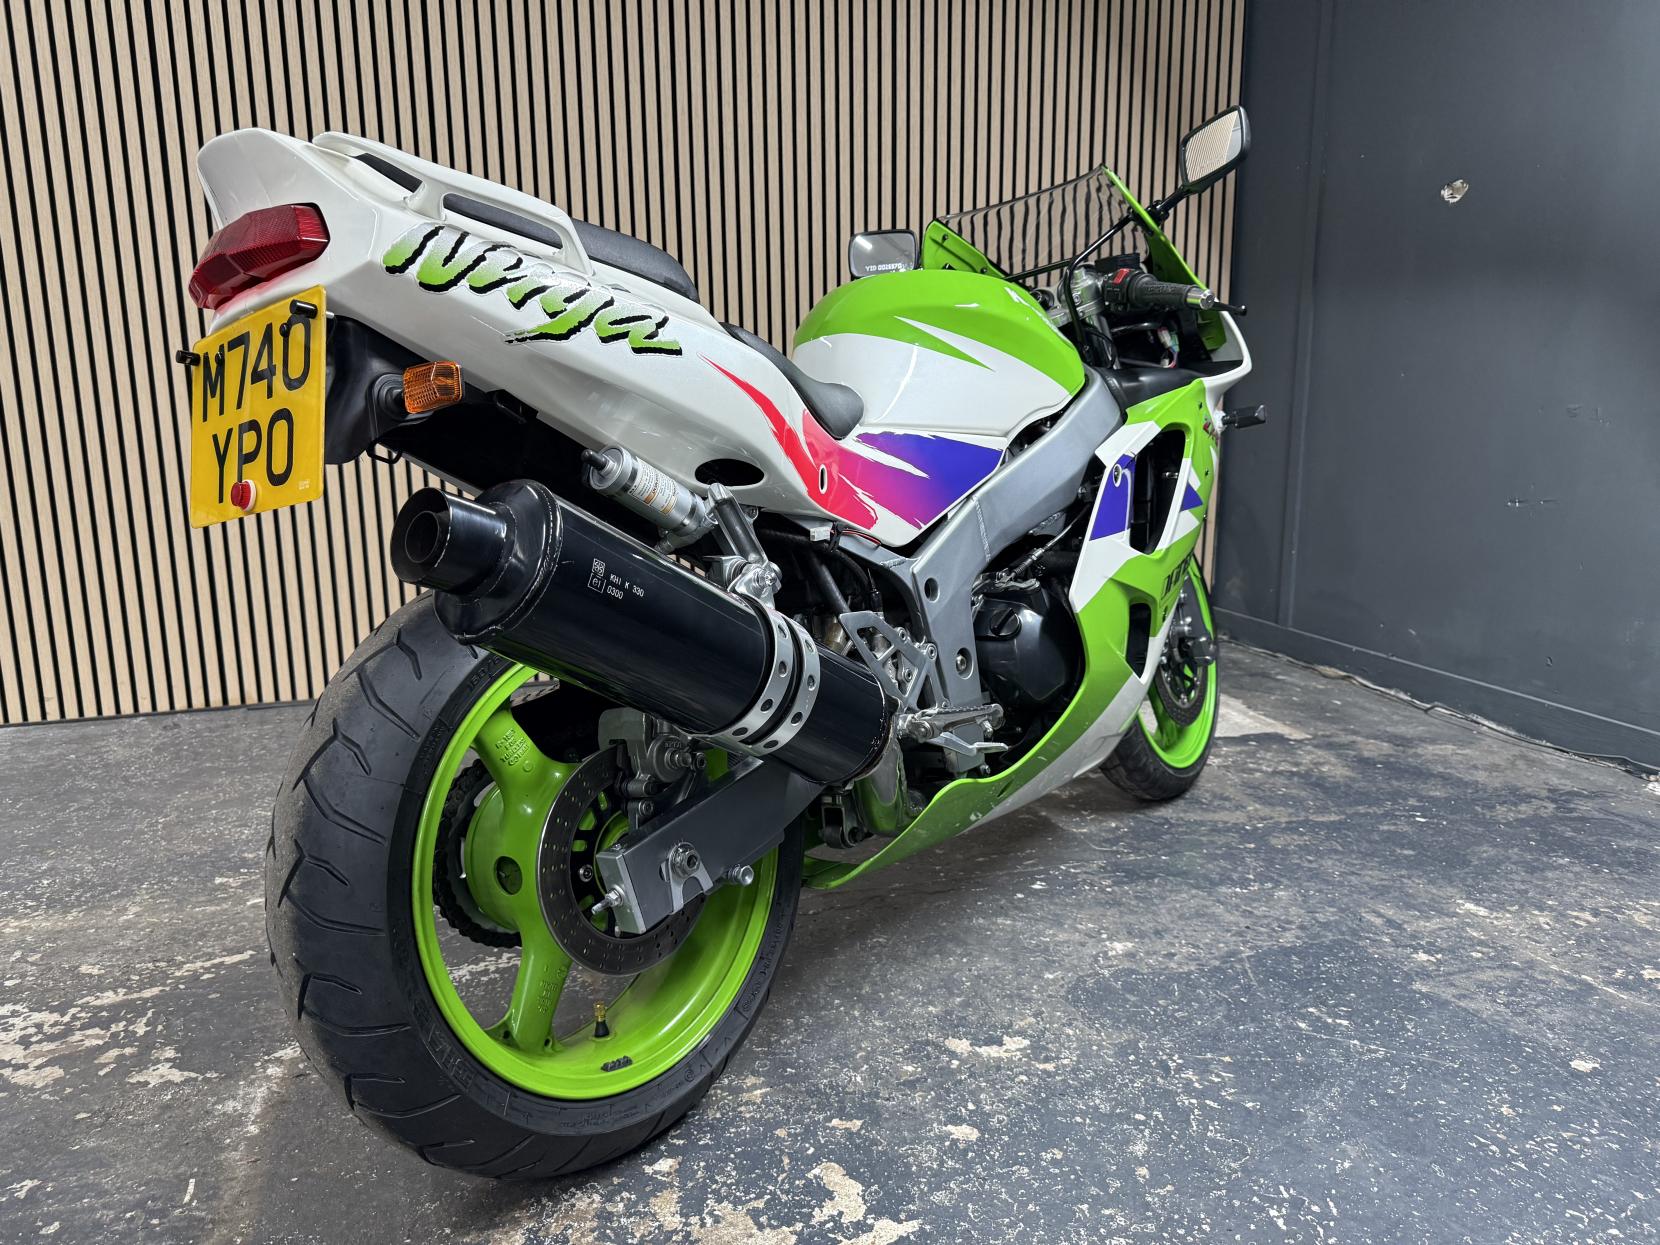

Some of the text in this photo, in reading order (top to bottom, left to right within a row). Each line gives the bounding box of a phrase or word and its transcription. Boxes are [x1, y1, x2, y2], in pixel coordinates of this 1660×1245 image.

[382, 224, 684, 357] Ninja
[202, 313, 311, 422] M740
[212, 408, 294, 504] YPO
[610, 574, 621, 585] KHI
